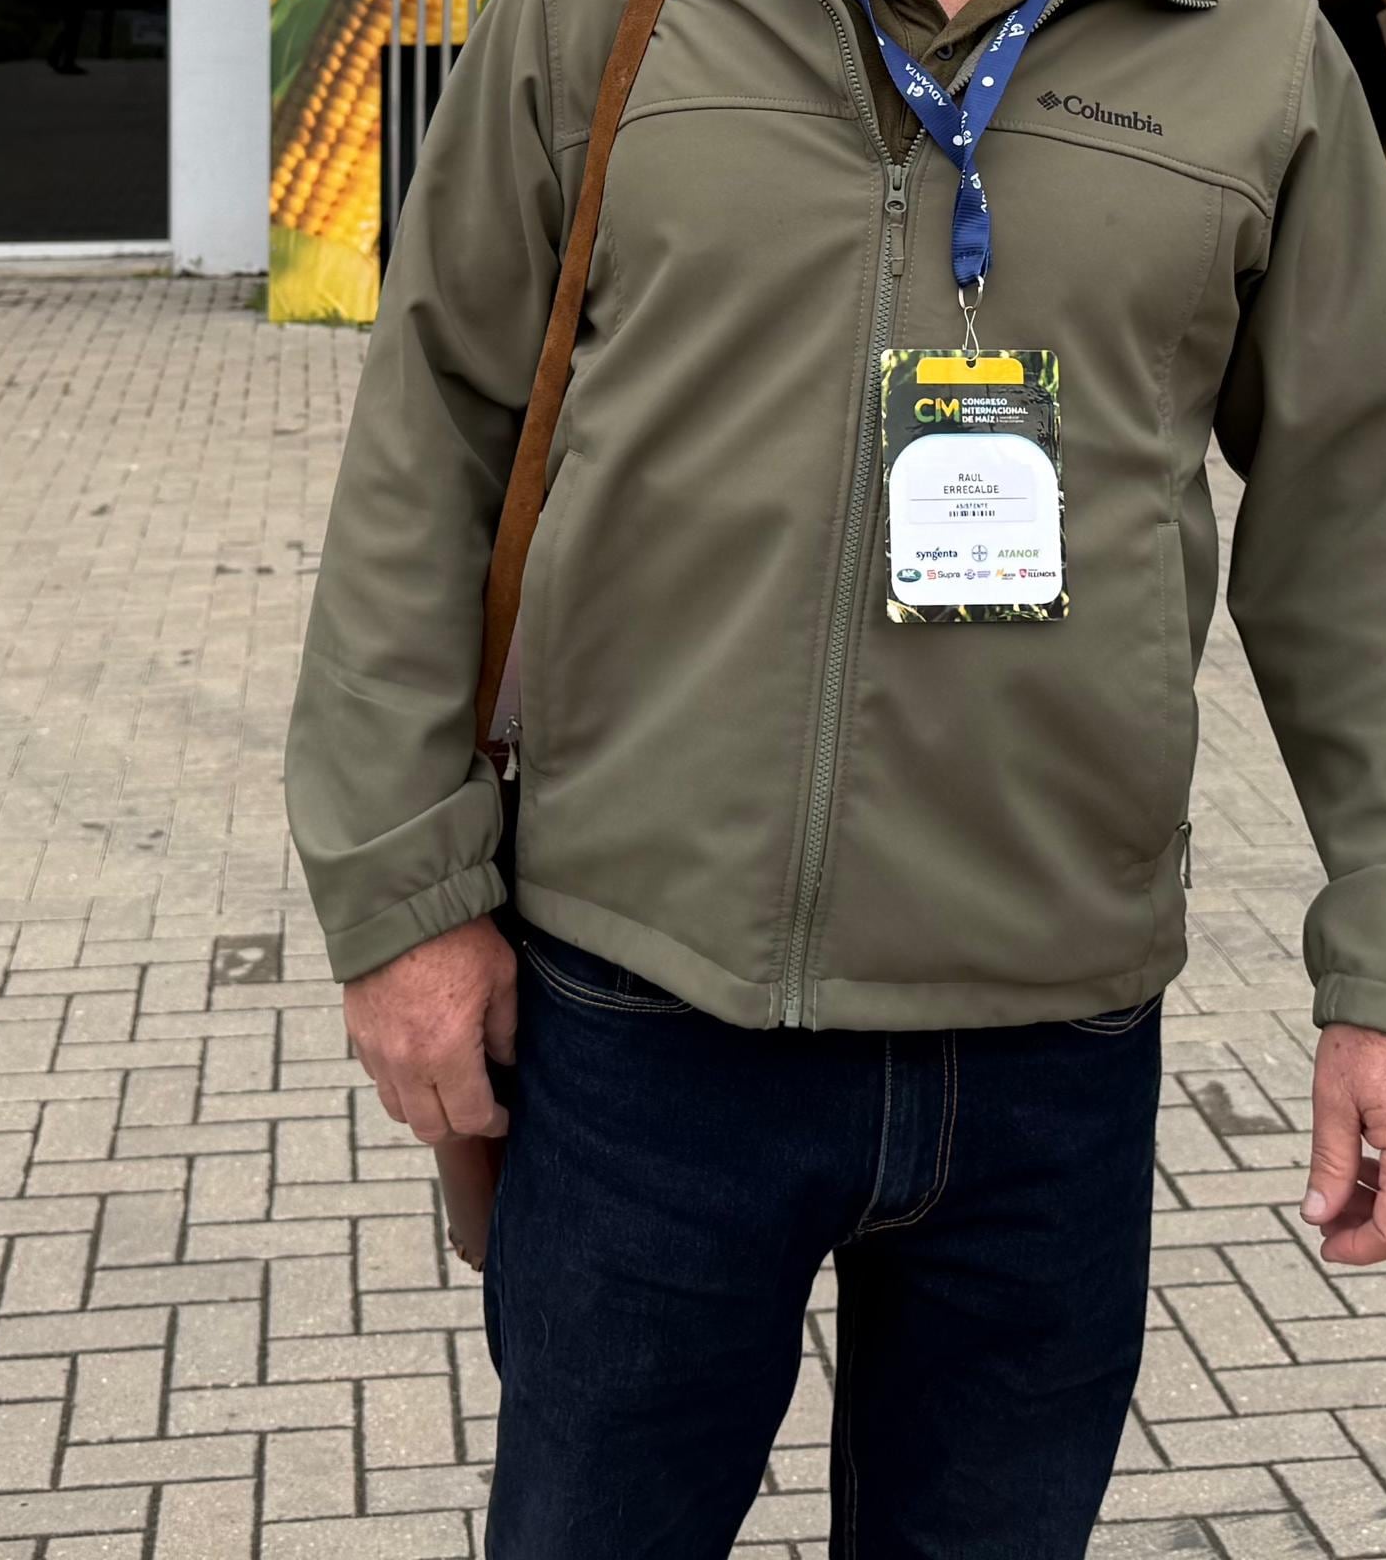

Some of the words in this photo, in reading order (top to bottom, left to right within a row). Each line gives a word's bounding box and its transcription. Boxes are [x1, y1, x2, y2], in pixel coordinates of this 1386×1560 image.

[905, 63, 947, 107] ADVANTA
[1063, 95, 1163, 137] Columbia
[962, 397, 1008, 406] CONGRESO
[961, 407, 1029, 415] INTERNACIONAL
[943, 484, 1000, 495] ERRECALDE
[916, 550, 958, 561] syngenta
[997, 549, 1039, 558] ATANOR
[938, 570, 961, 579] Supra
